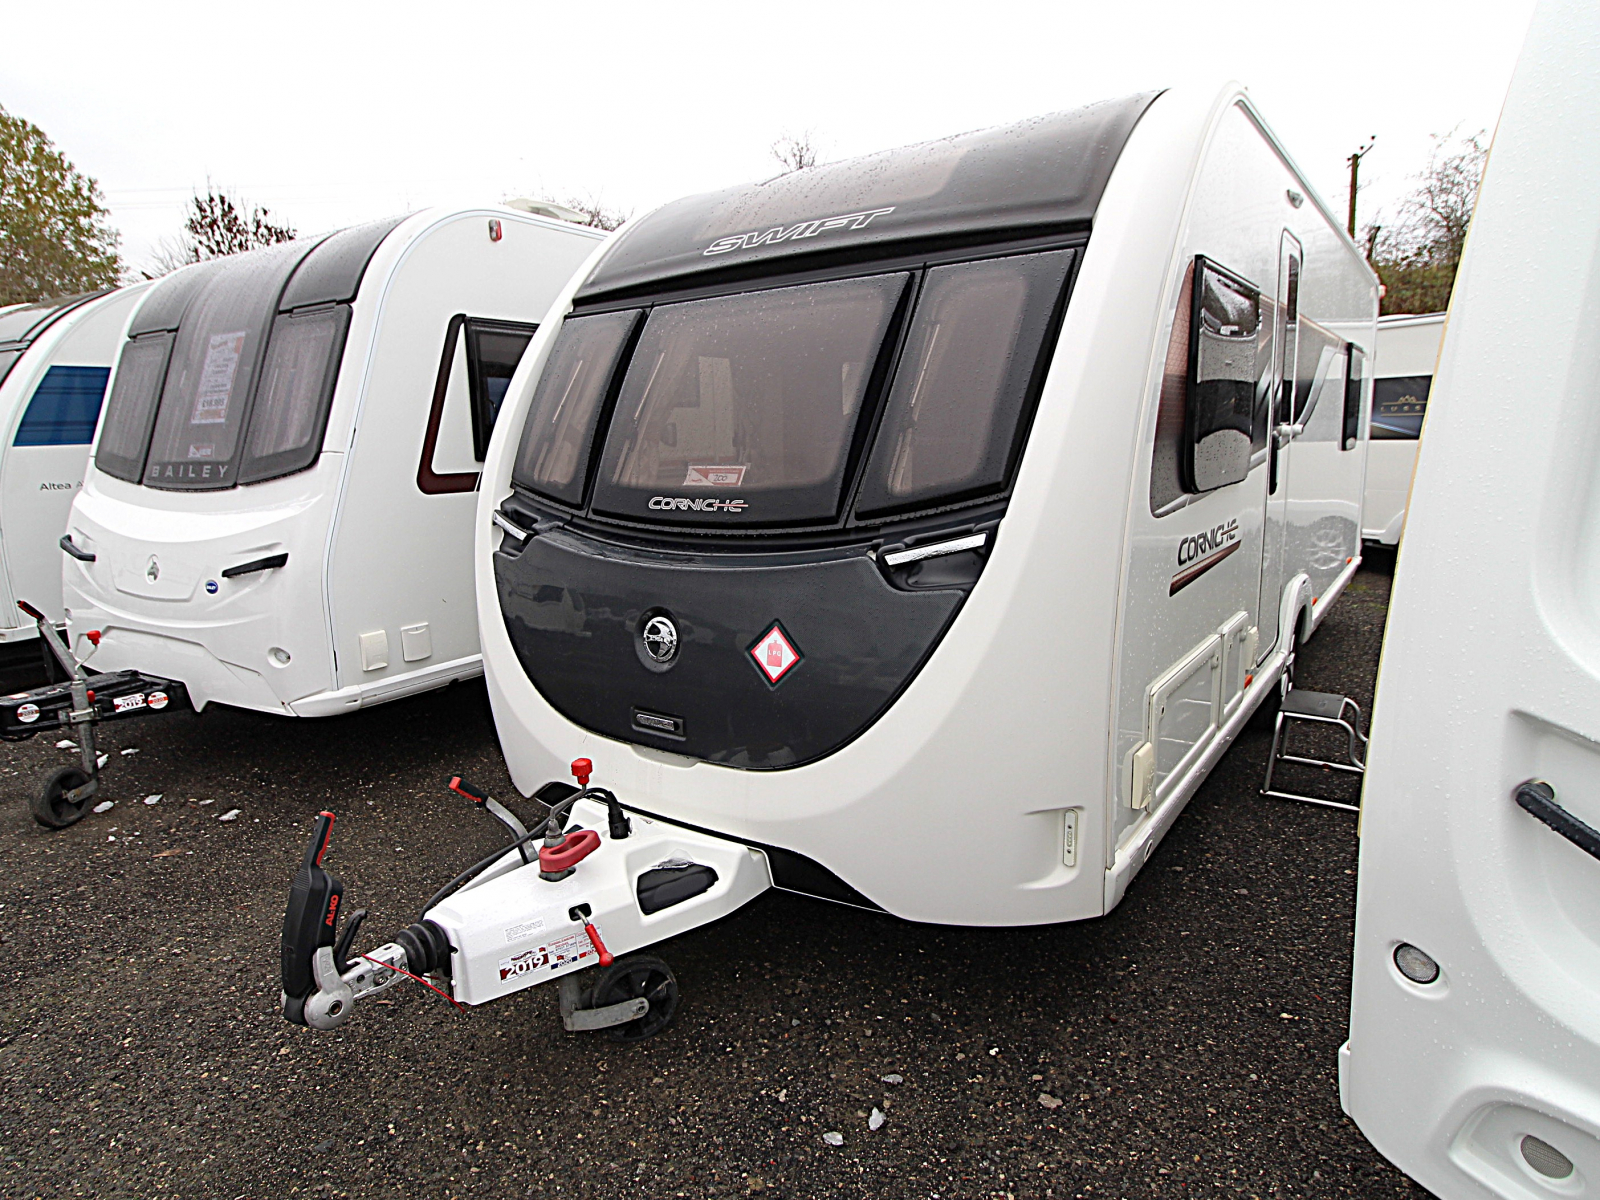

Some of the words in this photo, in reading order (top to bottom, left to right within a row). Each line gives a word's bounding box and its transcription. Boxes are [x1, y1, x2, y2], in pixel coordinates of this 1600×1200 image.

[703, 206, 896, 256] SWIFT
[1380, 404, 1422, 412] LUSS
[151, 465, 228, 478] BAILEY
[40, 482, 72, 491] Altea
[648, 496, 748, 512] CORNICHE
[1177, 518, 1239, 567] CORNICHE
[117, 698, 144, 710] 2019
[505, 955, 546, 979] 2019
